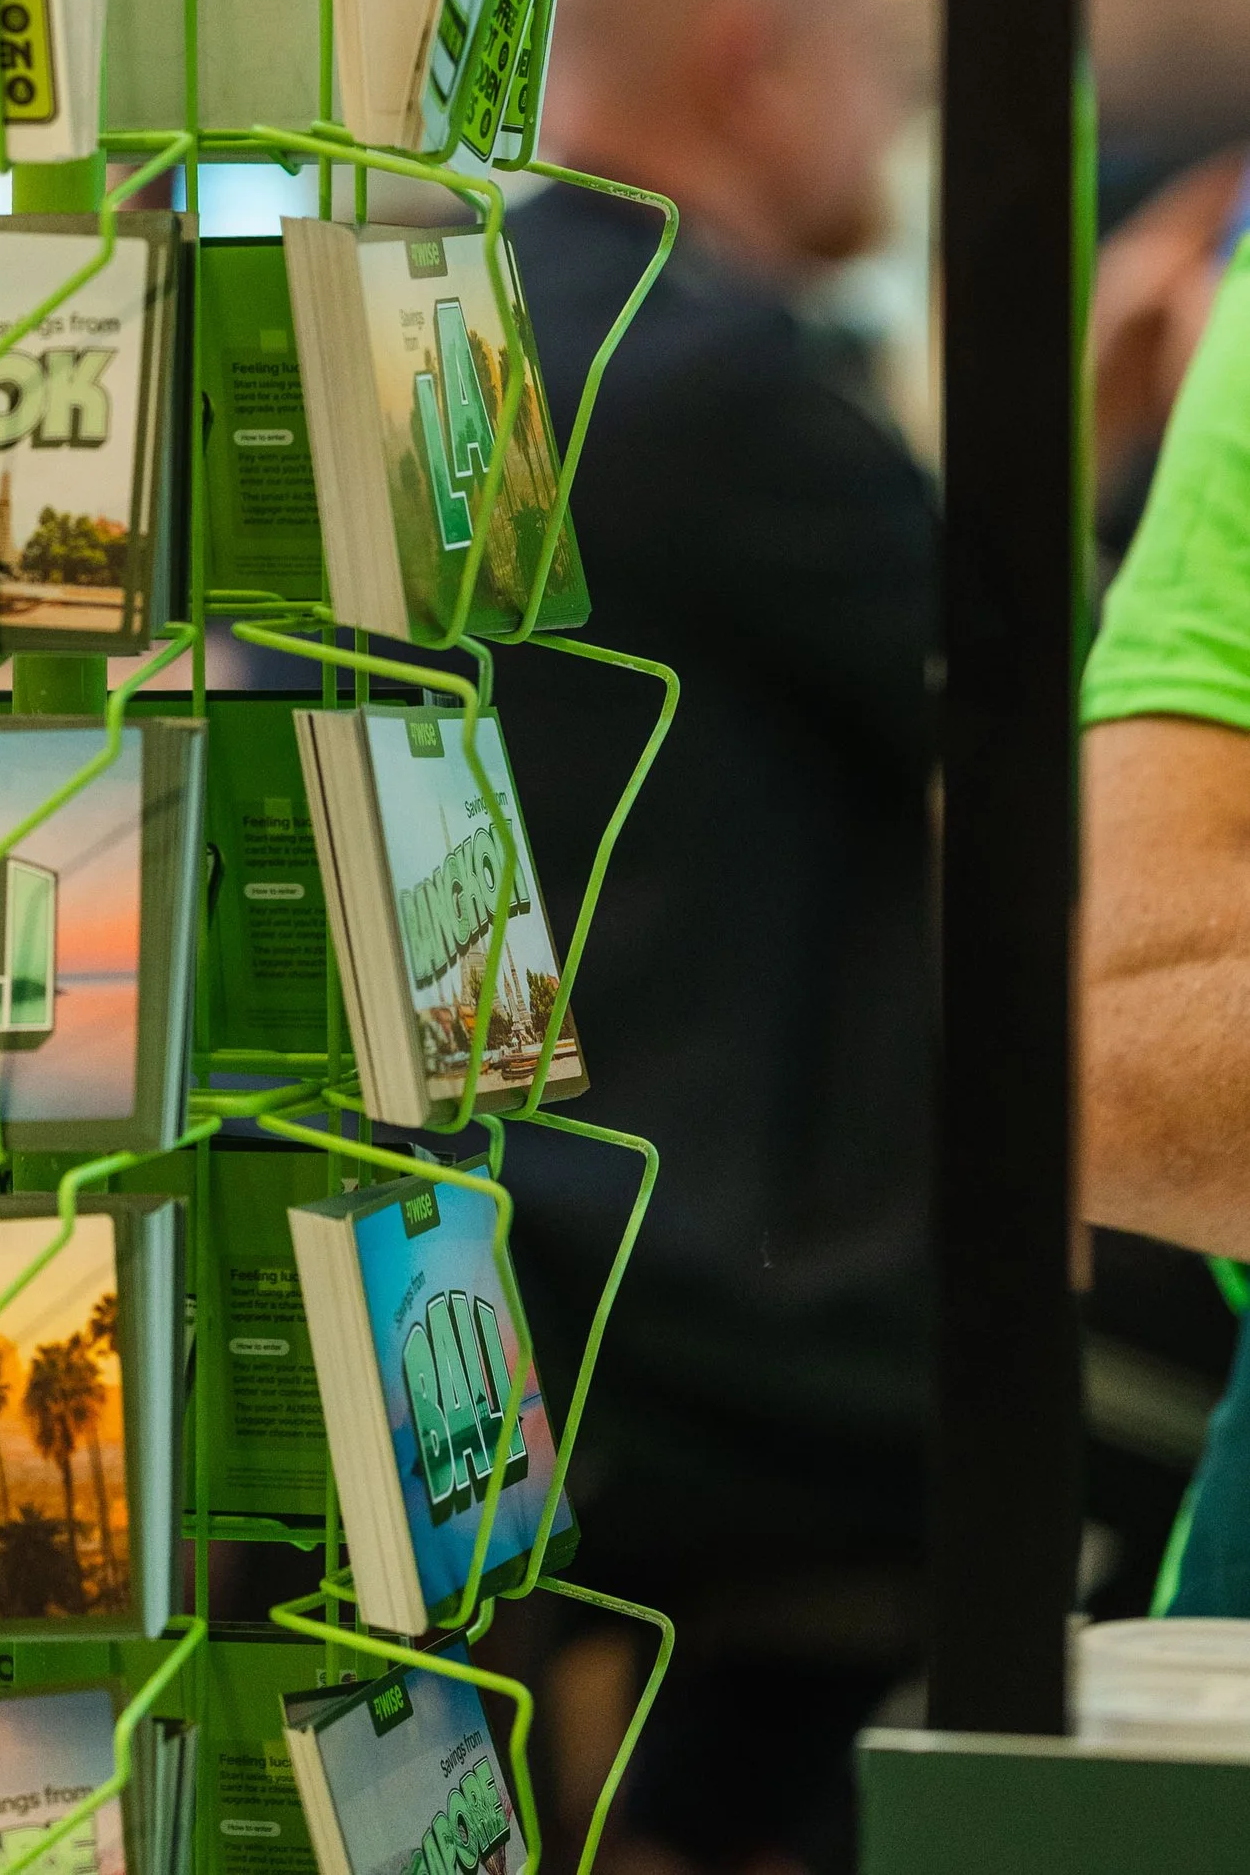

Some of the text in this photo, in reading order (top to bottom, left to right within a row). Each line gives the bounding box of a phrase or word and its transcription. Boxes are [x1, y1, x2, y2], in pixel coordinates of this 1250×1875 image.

[283, 361, 300, 374] luc
[464, 795, 488, 819] Saving
[281, 1270, 300, 1283] luc
[269, 1755, 292, 1768] luc
